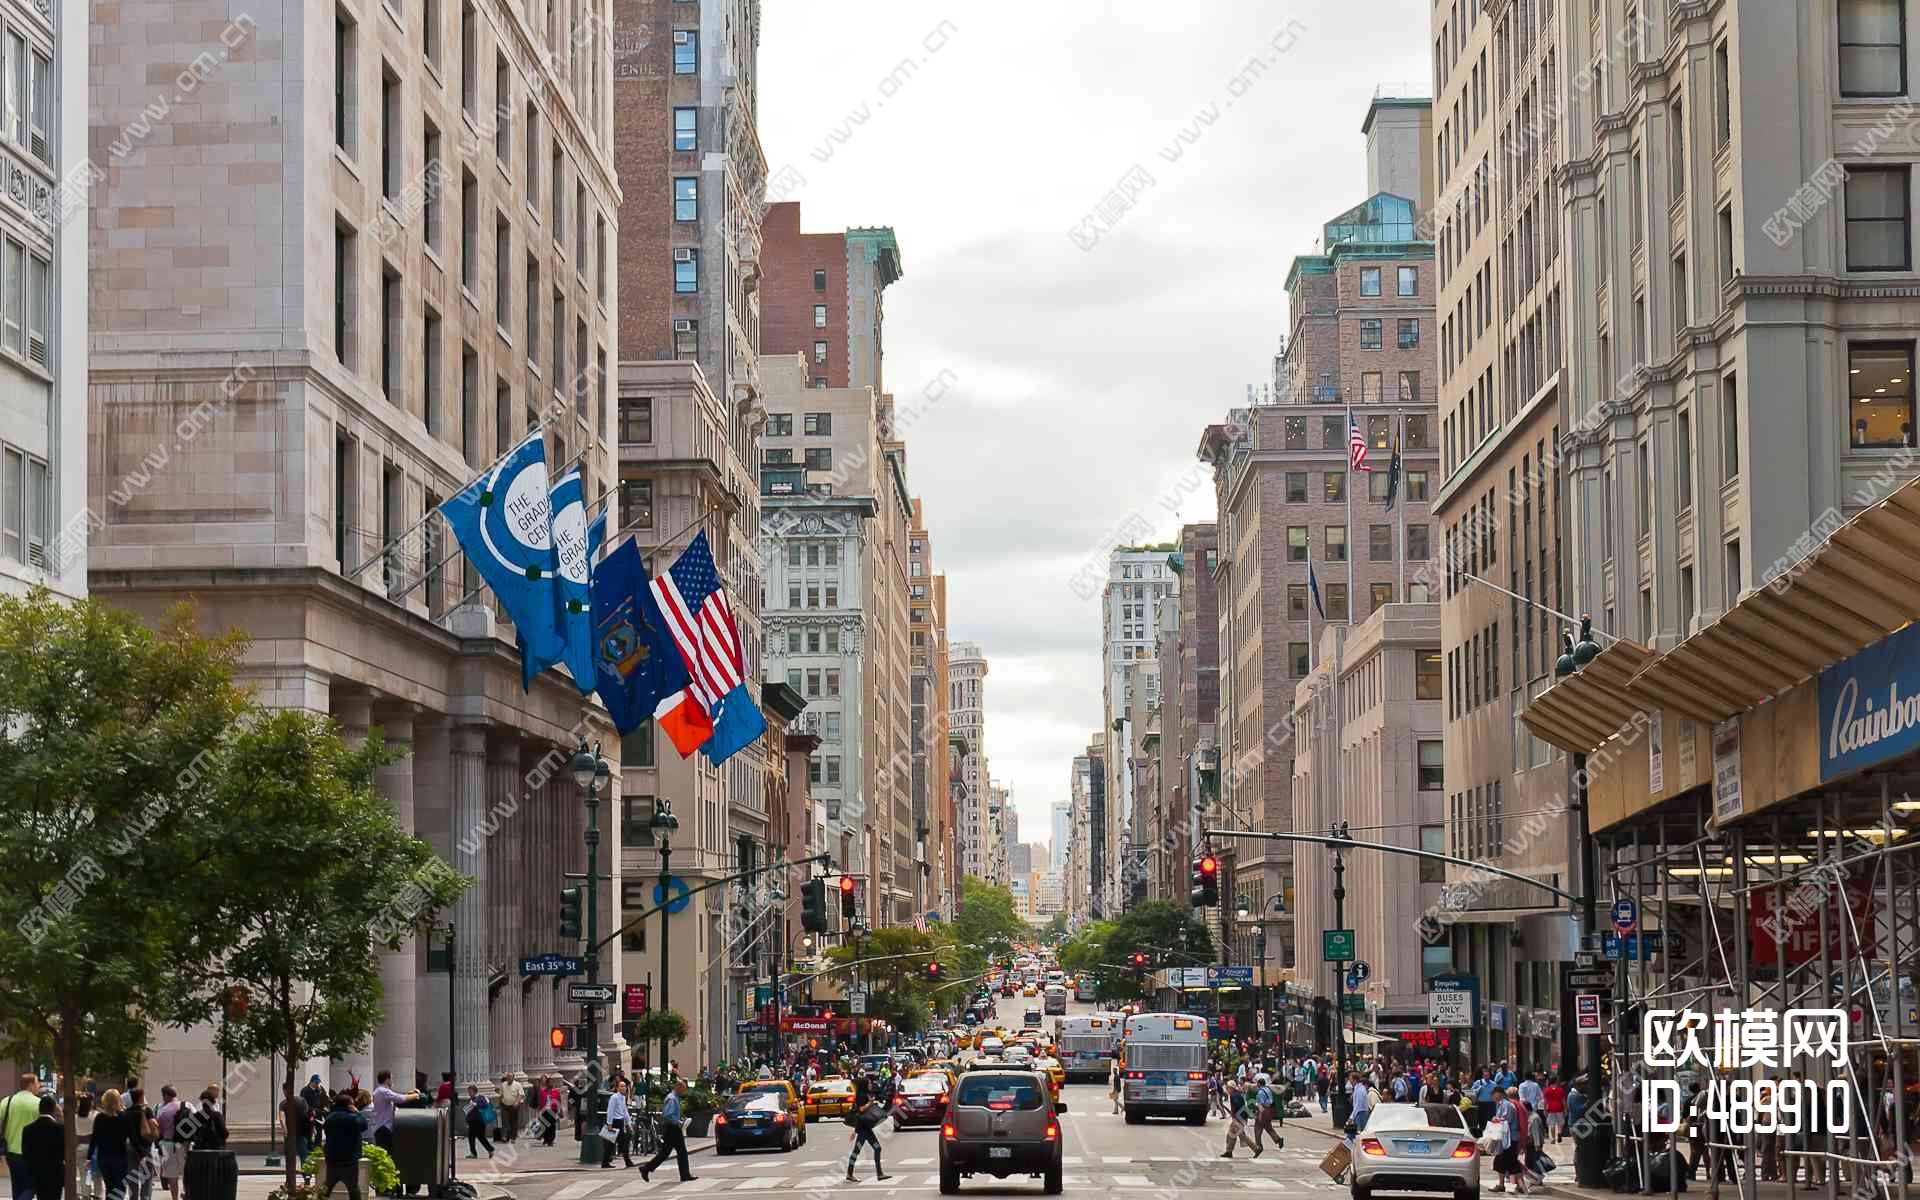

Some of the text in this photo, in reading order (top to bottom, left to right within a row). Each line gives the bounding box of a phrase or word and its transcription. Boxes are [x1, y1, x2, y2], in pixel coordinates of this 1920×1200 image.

[508, 492, 532, 516] THE
[525, 960, 576, 971] East 35th St
[1439, 1006, 1460, 1014] ONLY
